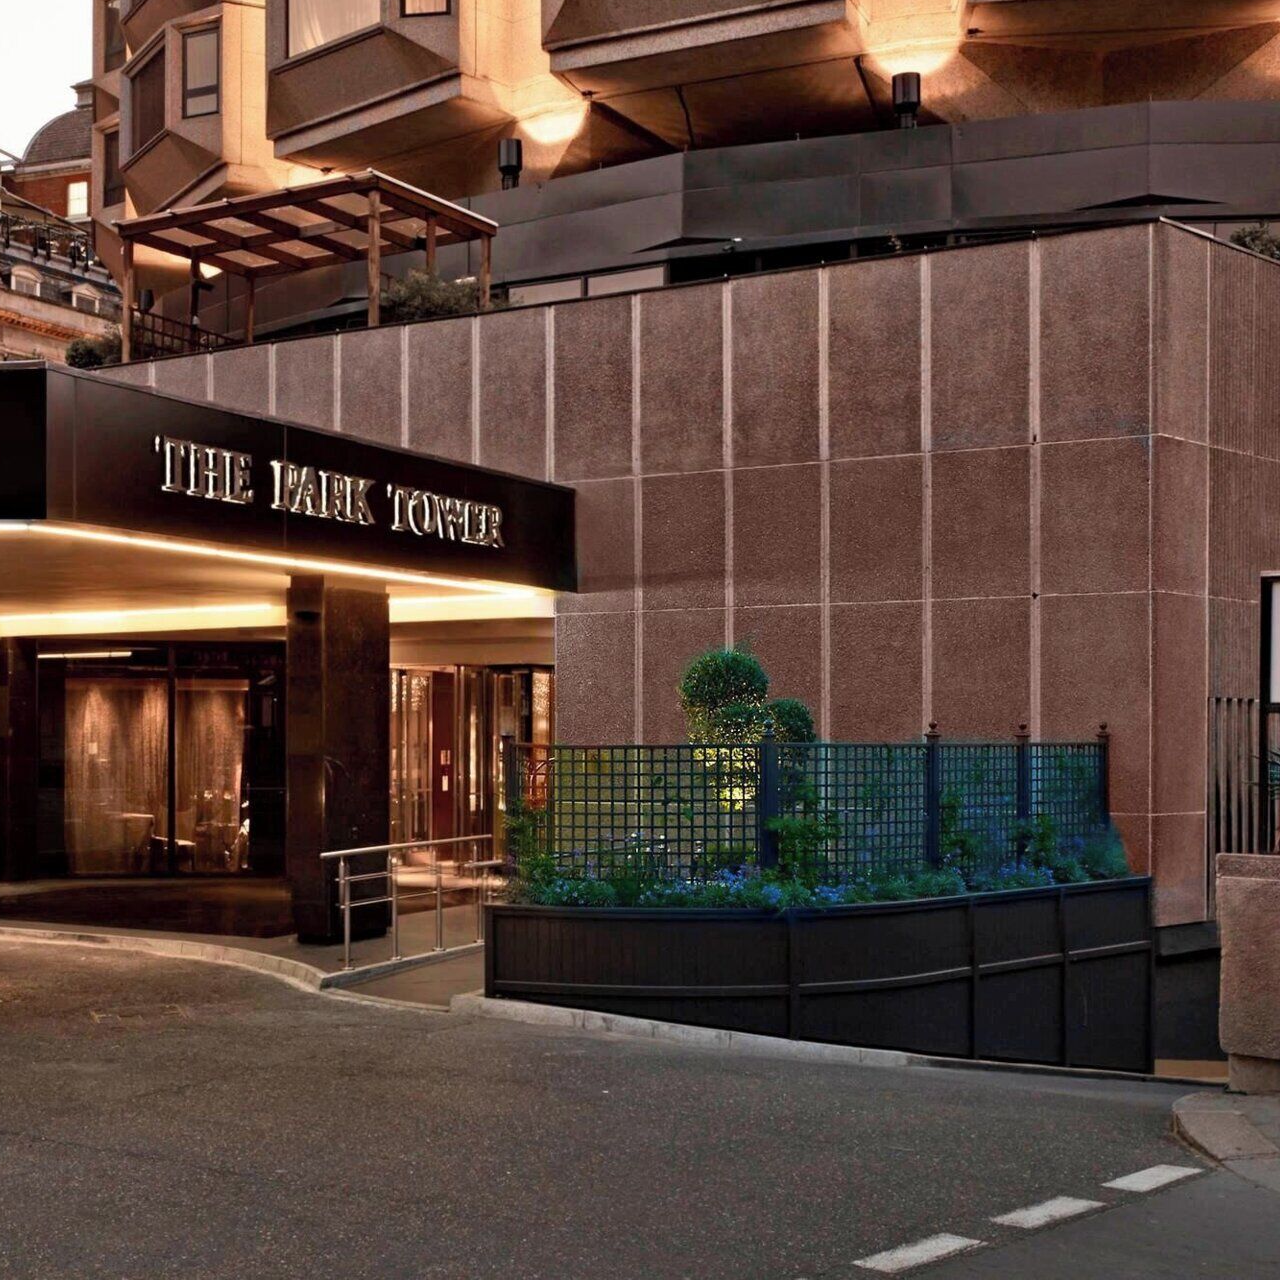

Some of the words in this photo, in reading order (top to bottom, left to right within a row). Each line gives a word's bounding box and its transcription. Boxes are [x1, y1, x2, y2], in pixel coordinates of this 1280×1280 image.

[155, 435, 254, 503] THE
[269, 460, 375, 525] PARK
[387, 483, 504, 547] TOWER
